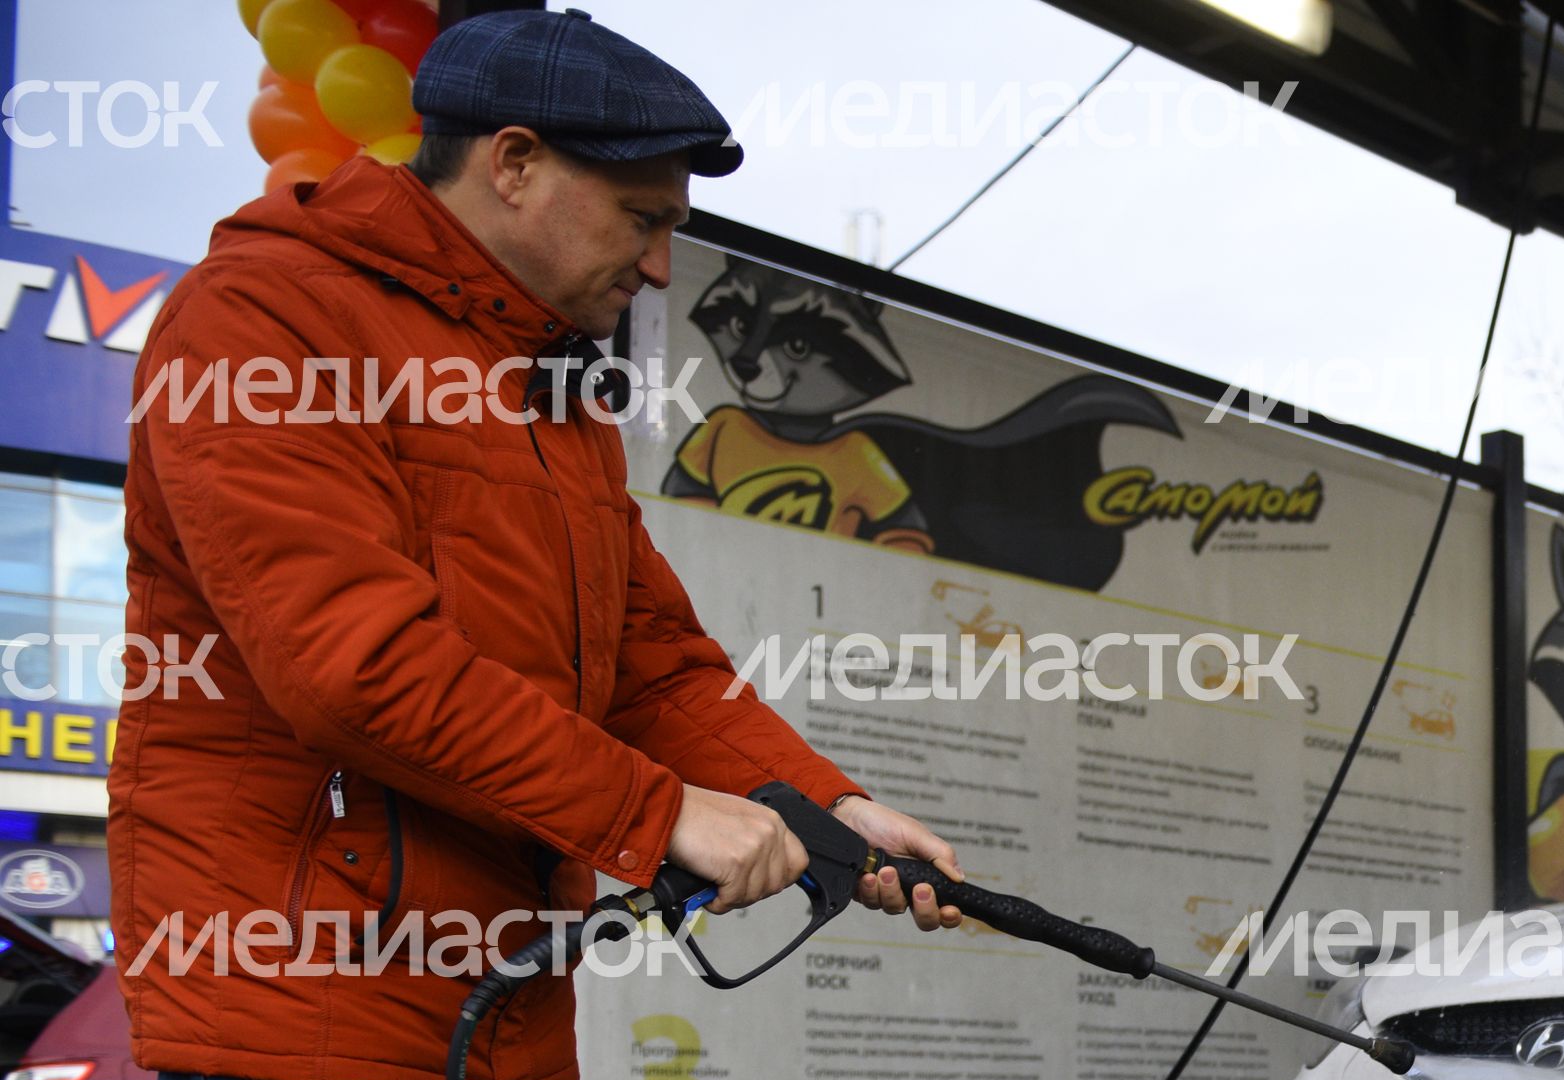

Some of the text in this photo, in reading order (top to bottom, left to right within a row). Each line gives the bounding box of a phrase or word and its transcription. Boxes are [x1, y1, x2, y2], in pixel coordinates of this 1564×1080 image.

[811, 585, 824, 619] 1
[1304, 684, 1319, 715] 3
[0, 708, 118, 765] НЕ
[805, 952, 881, 971] ГОРЯЧИЙ
[805, 973, 850, 990] ВОСК
